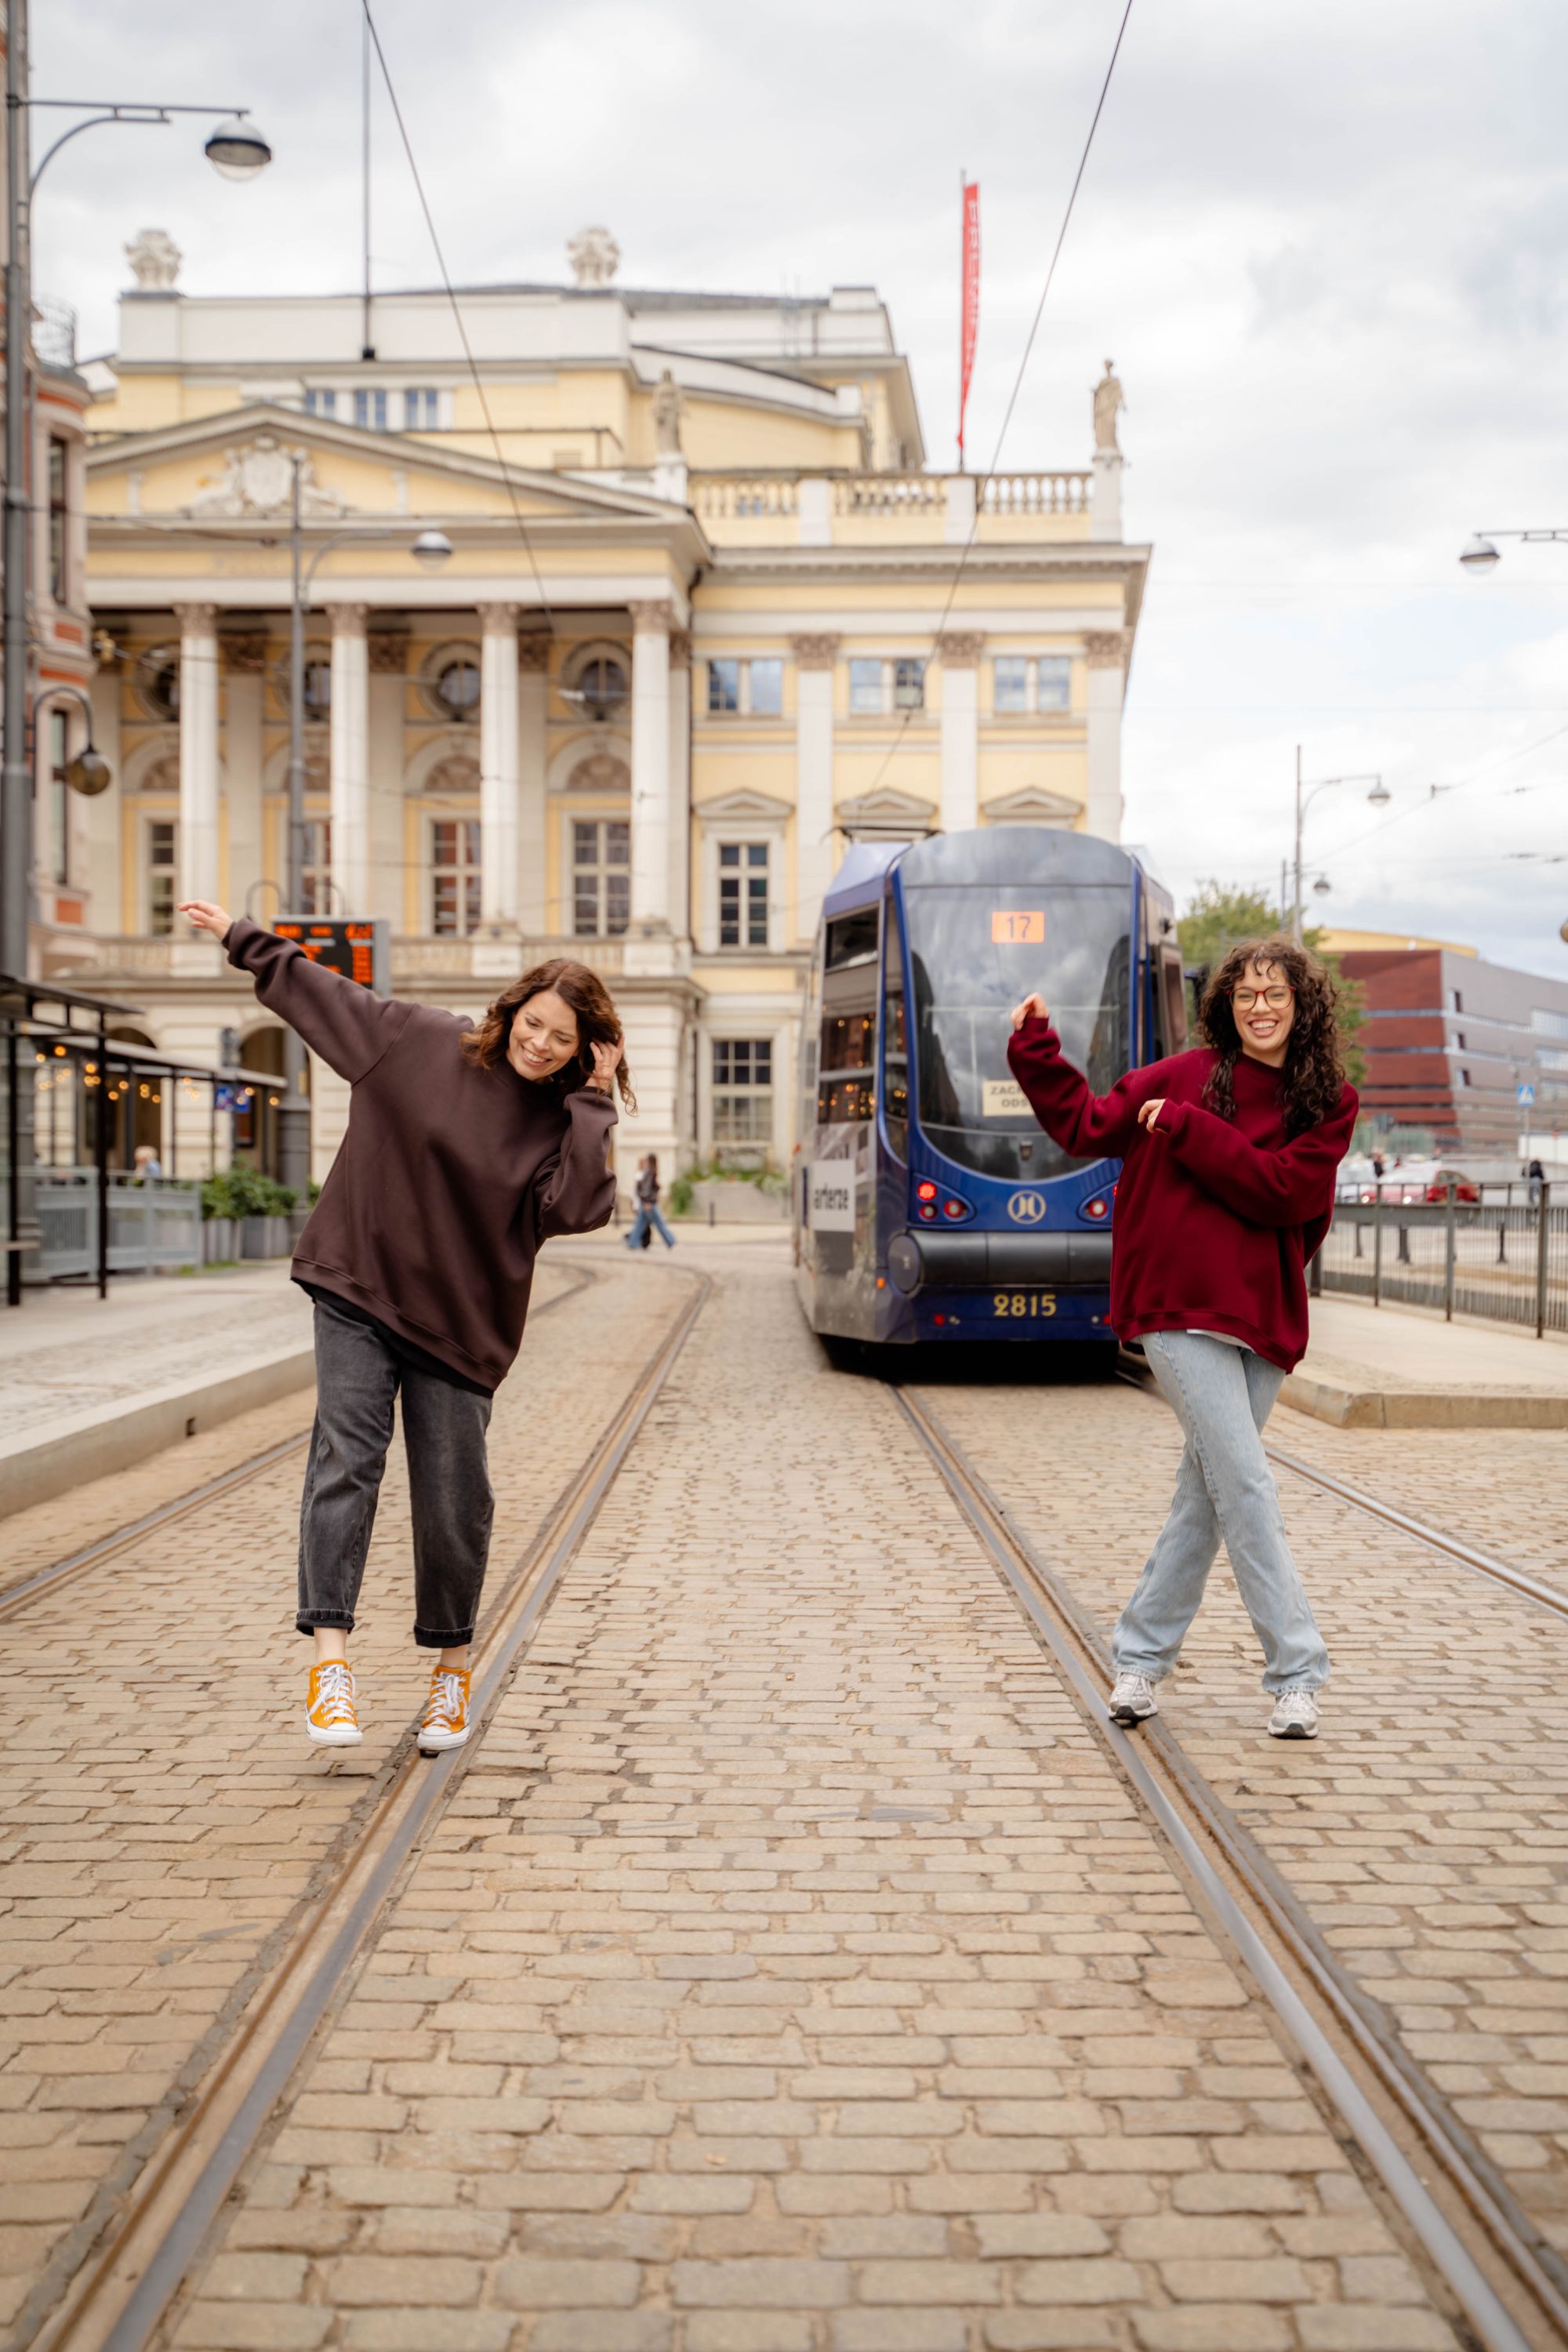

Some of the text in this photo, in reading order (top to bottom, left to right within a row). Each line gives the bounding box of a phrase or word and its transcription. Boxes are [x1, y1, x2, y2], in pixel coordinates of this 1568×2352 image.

[1006, 915, 1031, 938] 17
[1001, 1098, 1029, 1108] ODS
[993, 1294, 1057, 1317] 2815
